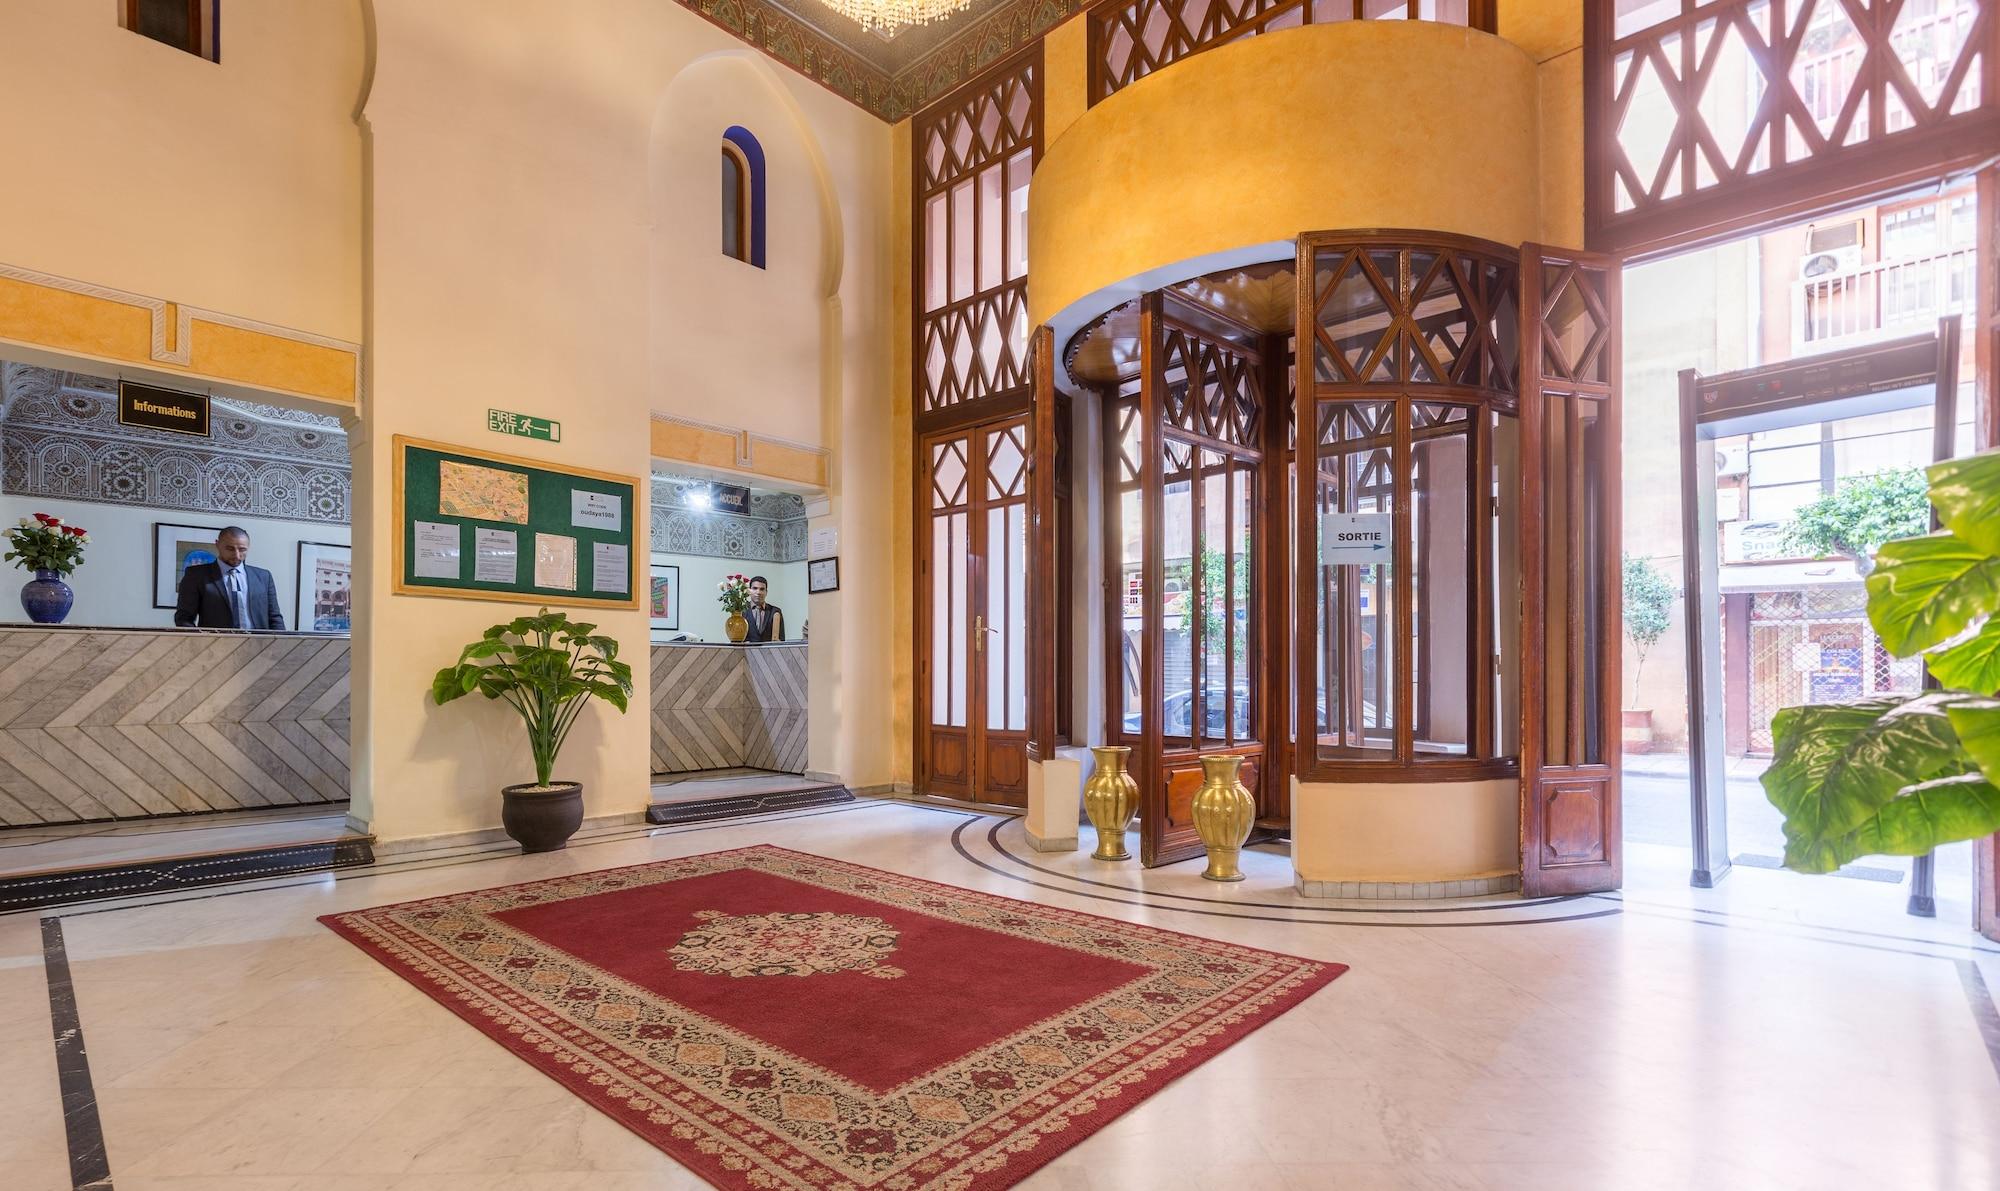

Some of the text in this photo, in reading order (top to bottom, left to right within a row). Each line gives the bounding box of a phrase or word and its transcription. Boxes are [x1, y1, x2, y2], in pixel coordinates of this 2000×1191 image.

[133, 399, 197, 419] Informations
[489, 410, 517, 424] FIRE
[489, 420, 517, 434] EXIT
[1338, 532, 1382, 541] SORTIE
